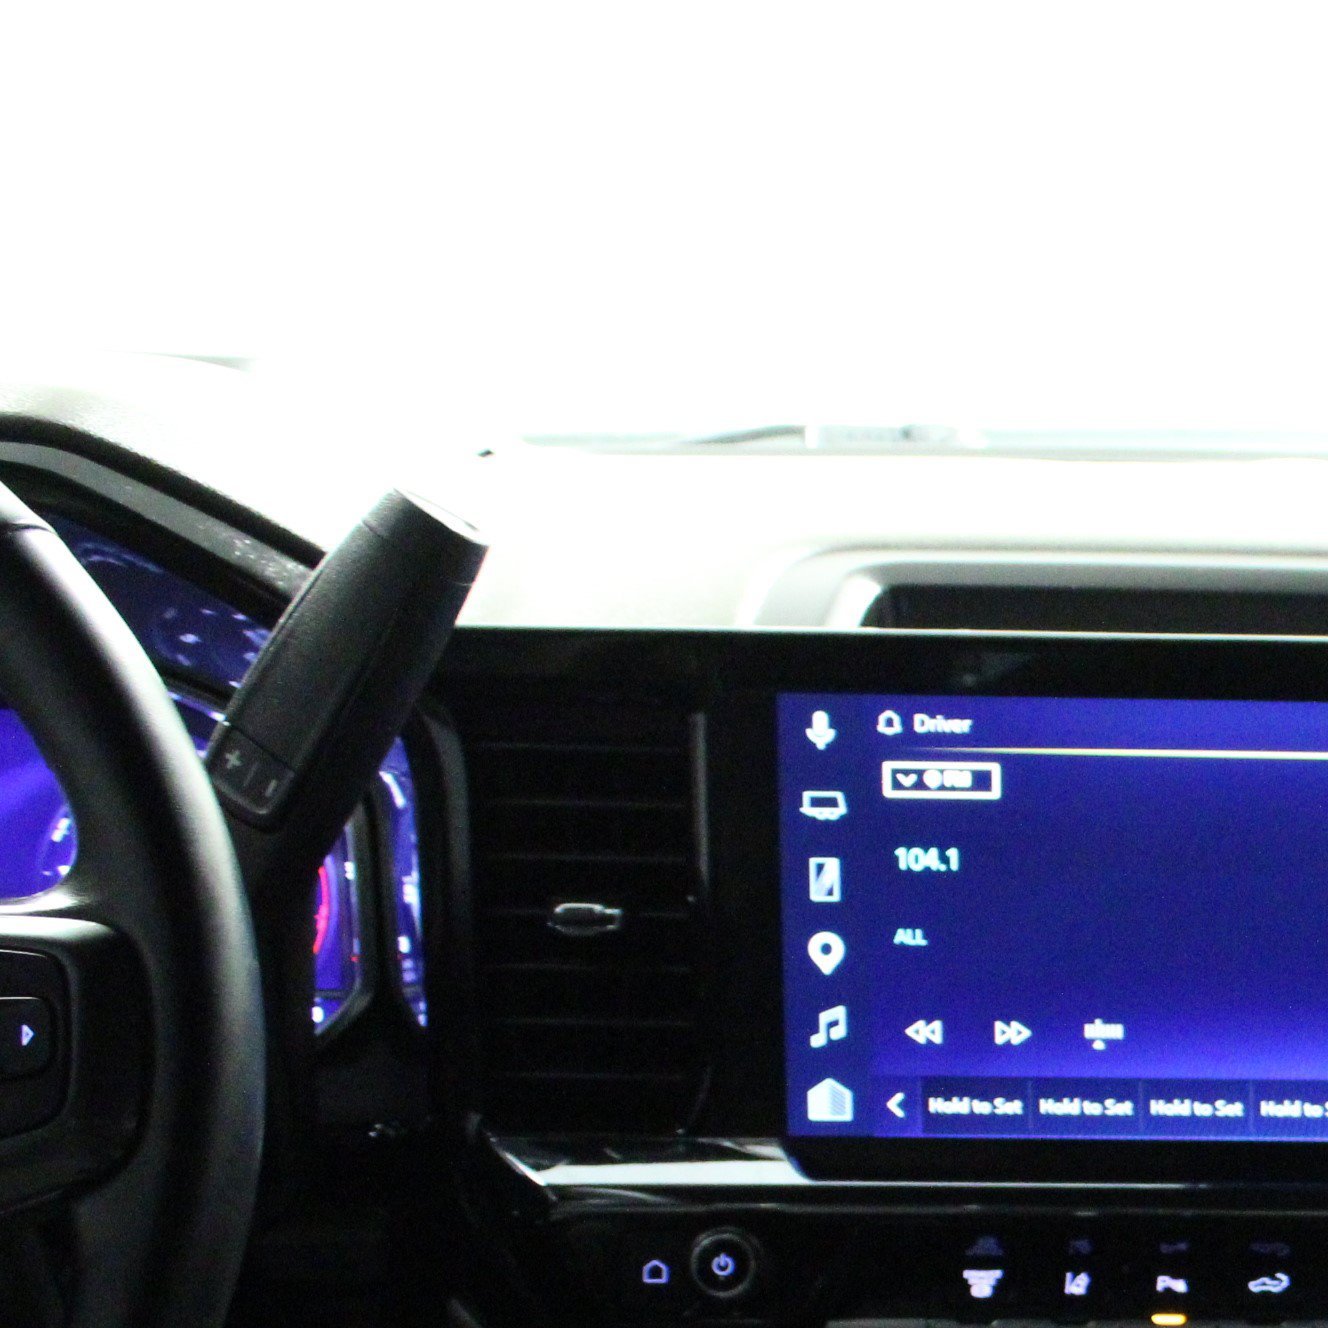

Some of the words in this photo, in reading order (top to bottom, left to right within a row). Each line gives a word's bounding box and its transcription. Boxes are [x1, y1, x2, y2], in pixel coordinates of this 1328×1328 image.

[914, 713, 972, 734] Driver
[894, 847, 959, 872] 104.1
[893, 928, 928, 946] ALL
[929, 1097, 971, 1114] Hold
[971, 1099, 993, 1115] to
[993, 1097, 1023, 1115] Set
[1039, 1098, 1082, 1115] Hold
[1082, 1100, 1104, 1116] to
[1104, 1098, 1134, 1116] Set
[1150, 1099, 1192, 1116] Hold
[1192, 1101, 1214, 1117] to
[1214, 1100, 1244, 1117] Set
[1260, 1100, 1302, 1118] Hold
[1302, 1102, 1324, 1118] to
